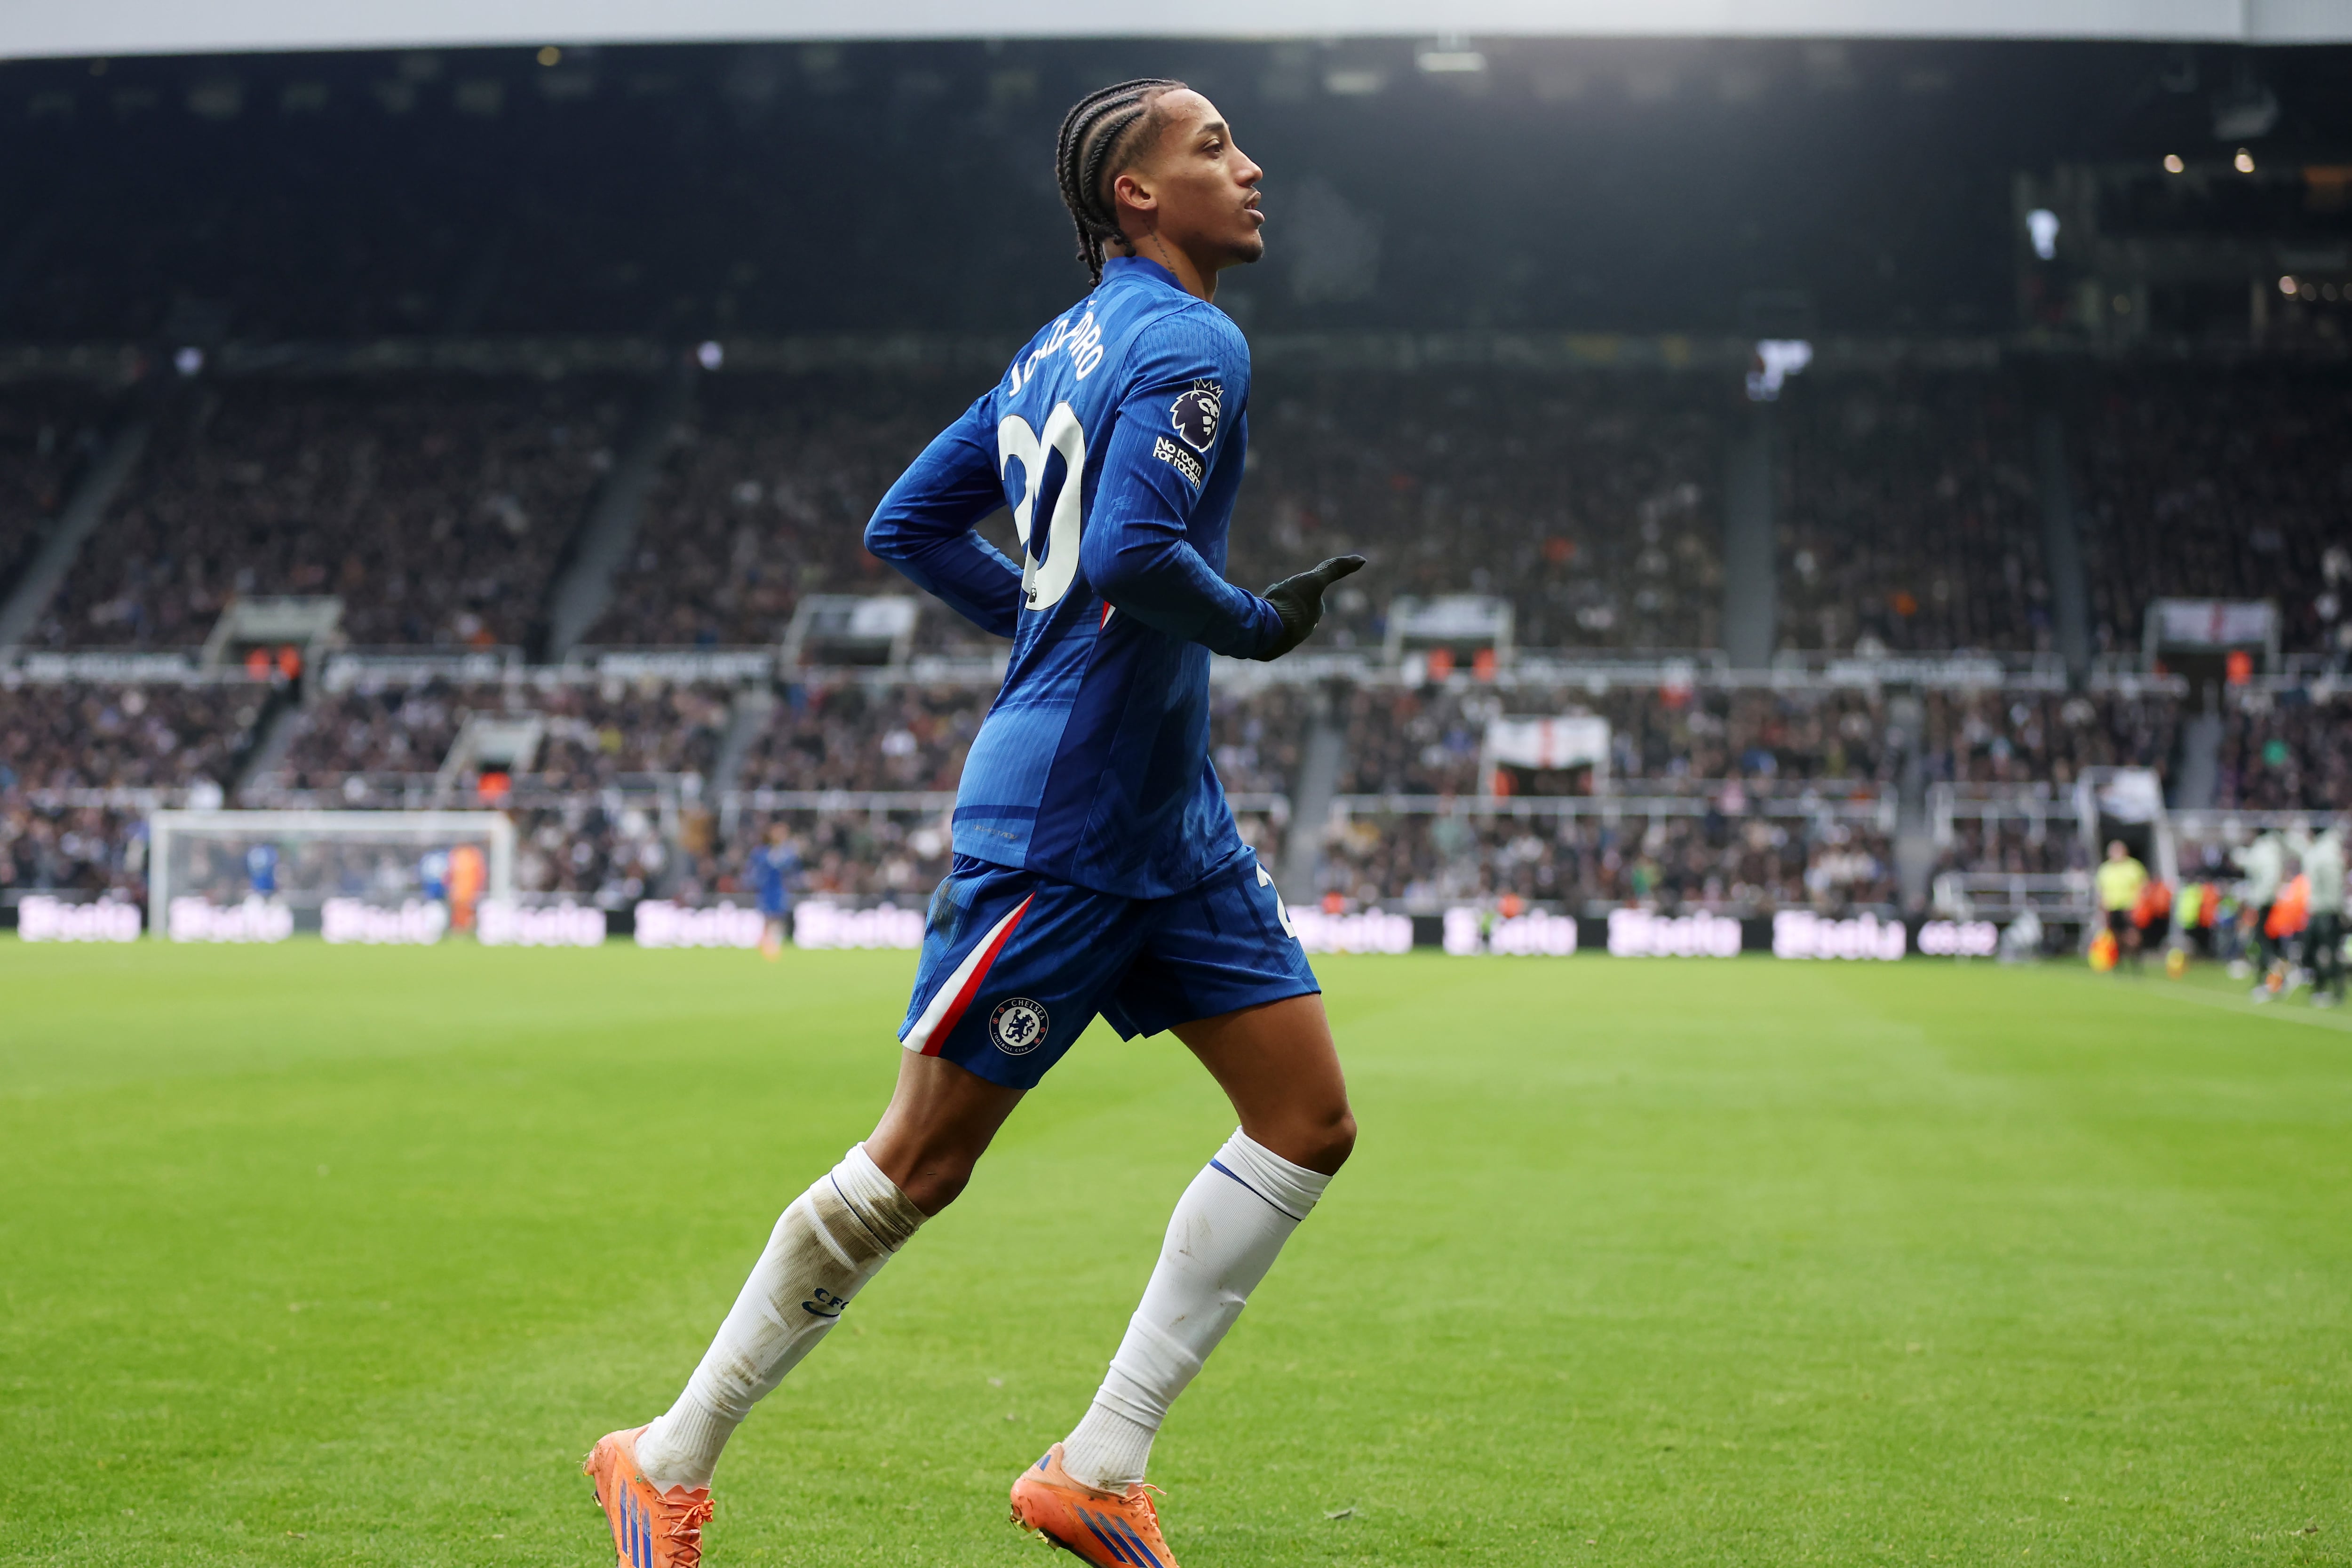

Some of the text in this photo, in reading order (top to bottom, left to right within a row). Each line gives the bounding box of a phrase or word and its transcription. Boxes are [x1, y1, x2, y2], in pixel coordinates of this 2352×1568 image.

[1156, 436, 1201, 477] No room
[1173, 457, 1200, 490] racism
[997, 400, 1086, 611] 20
[1011, 1000, 1045, 1020] CHELSEA
[993, 1032, 1012, 1051] FOOTBALL
